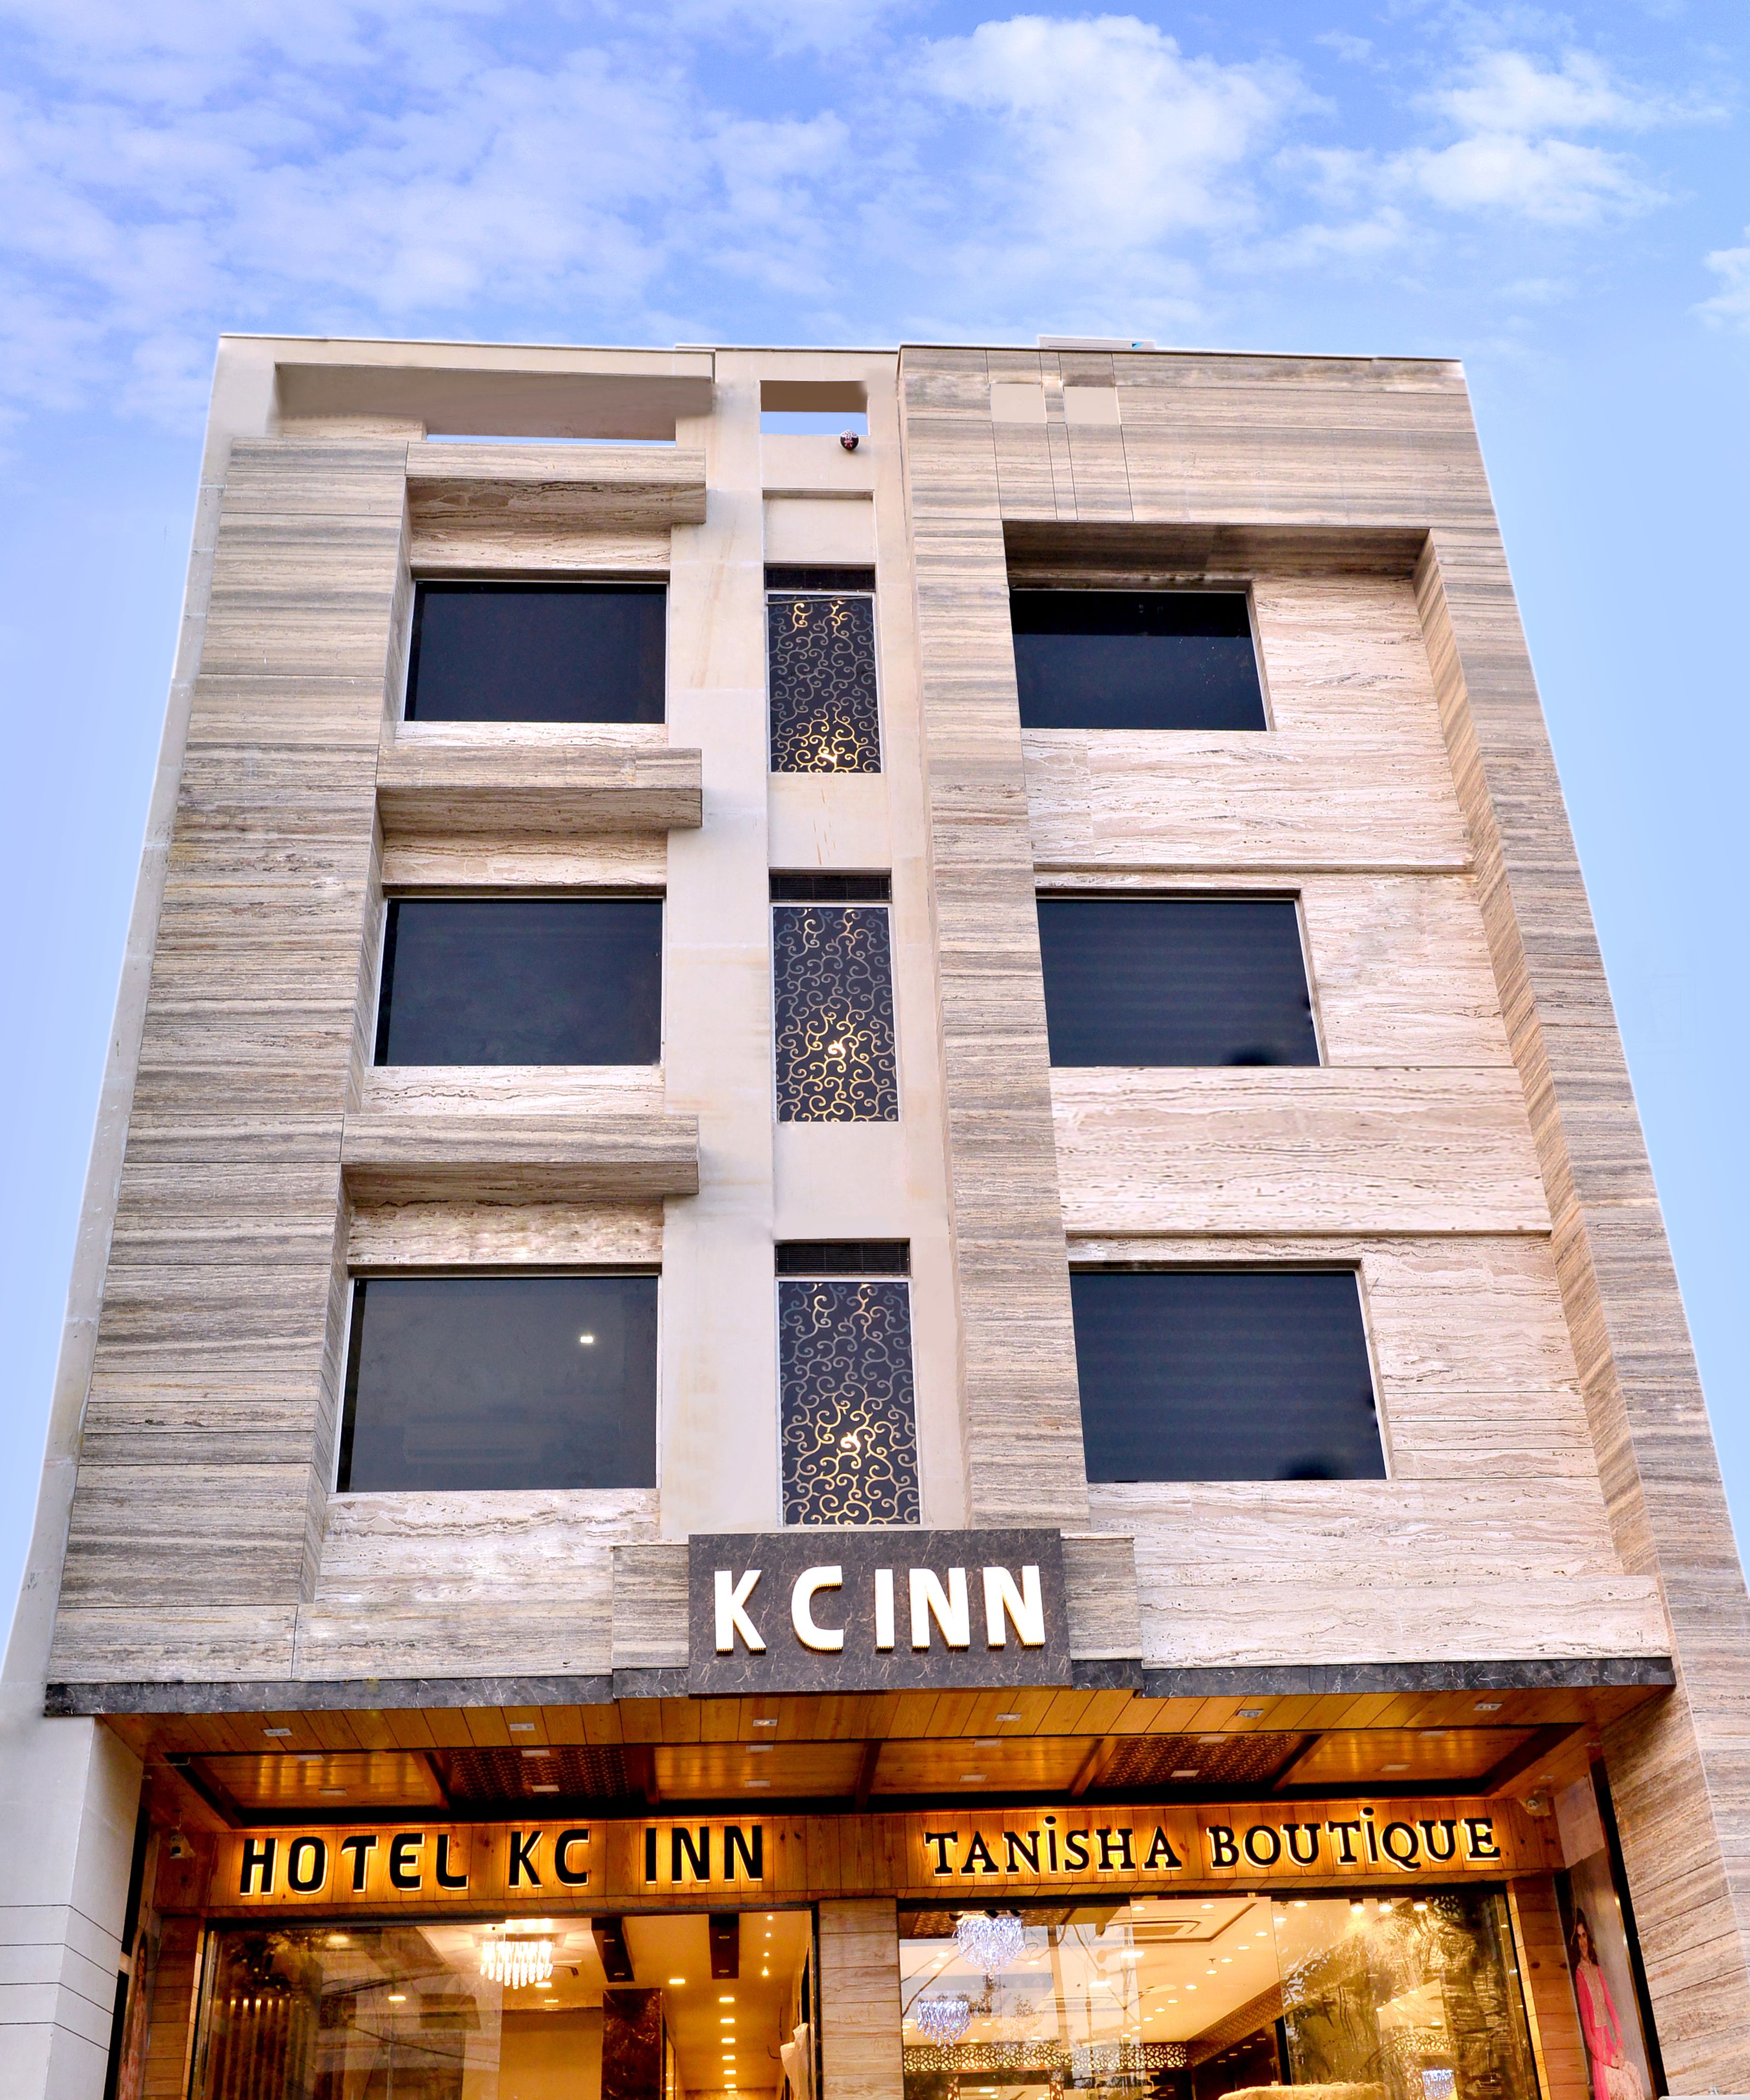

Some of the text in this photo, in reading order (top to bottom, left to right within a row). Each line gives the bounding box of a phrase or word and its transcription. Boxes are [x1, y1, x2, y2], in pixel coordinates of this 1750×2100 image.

[875, 1565, 1045, 1648] INN
[240, 1825, 763, 1895] HOTEL KC INN
[924, 1807, 1500, 1877] TANiSHA BOUTiQUE
